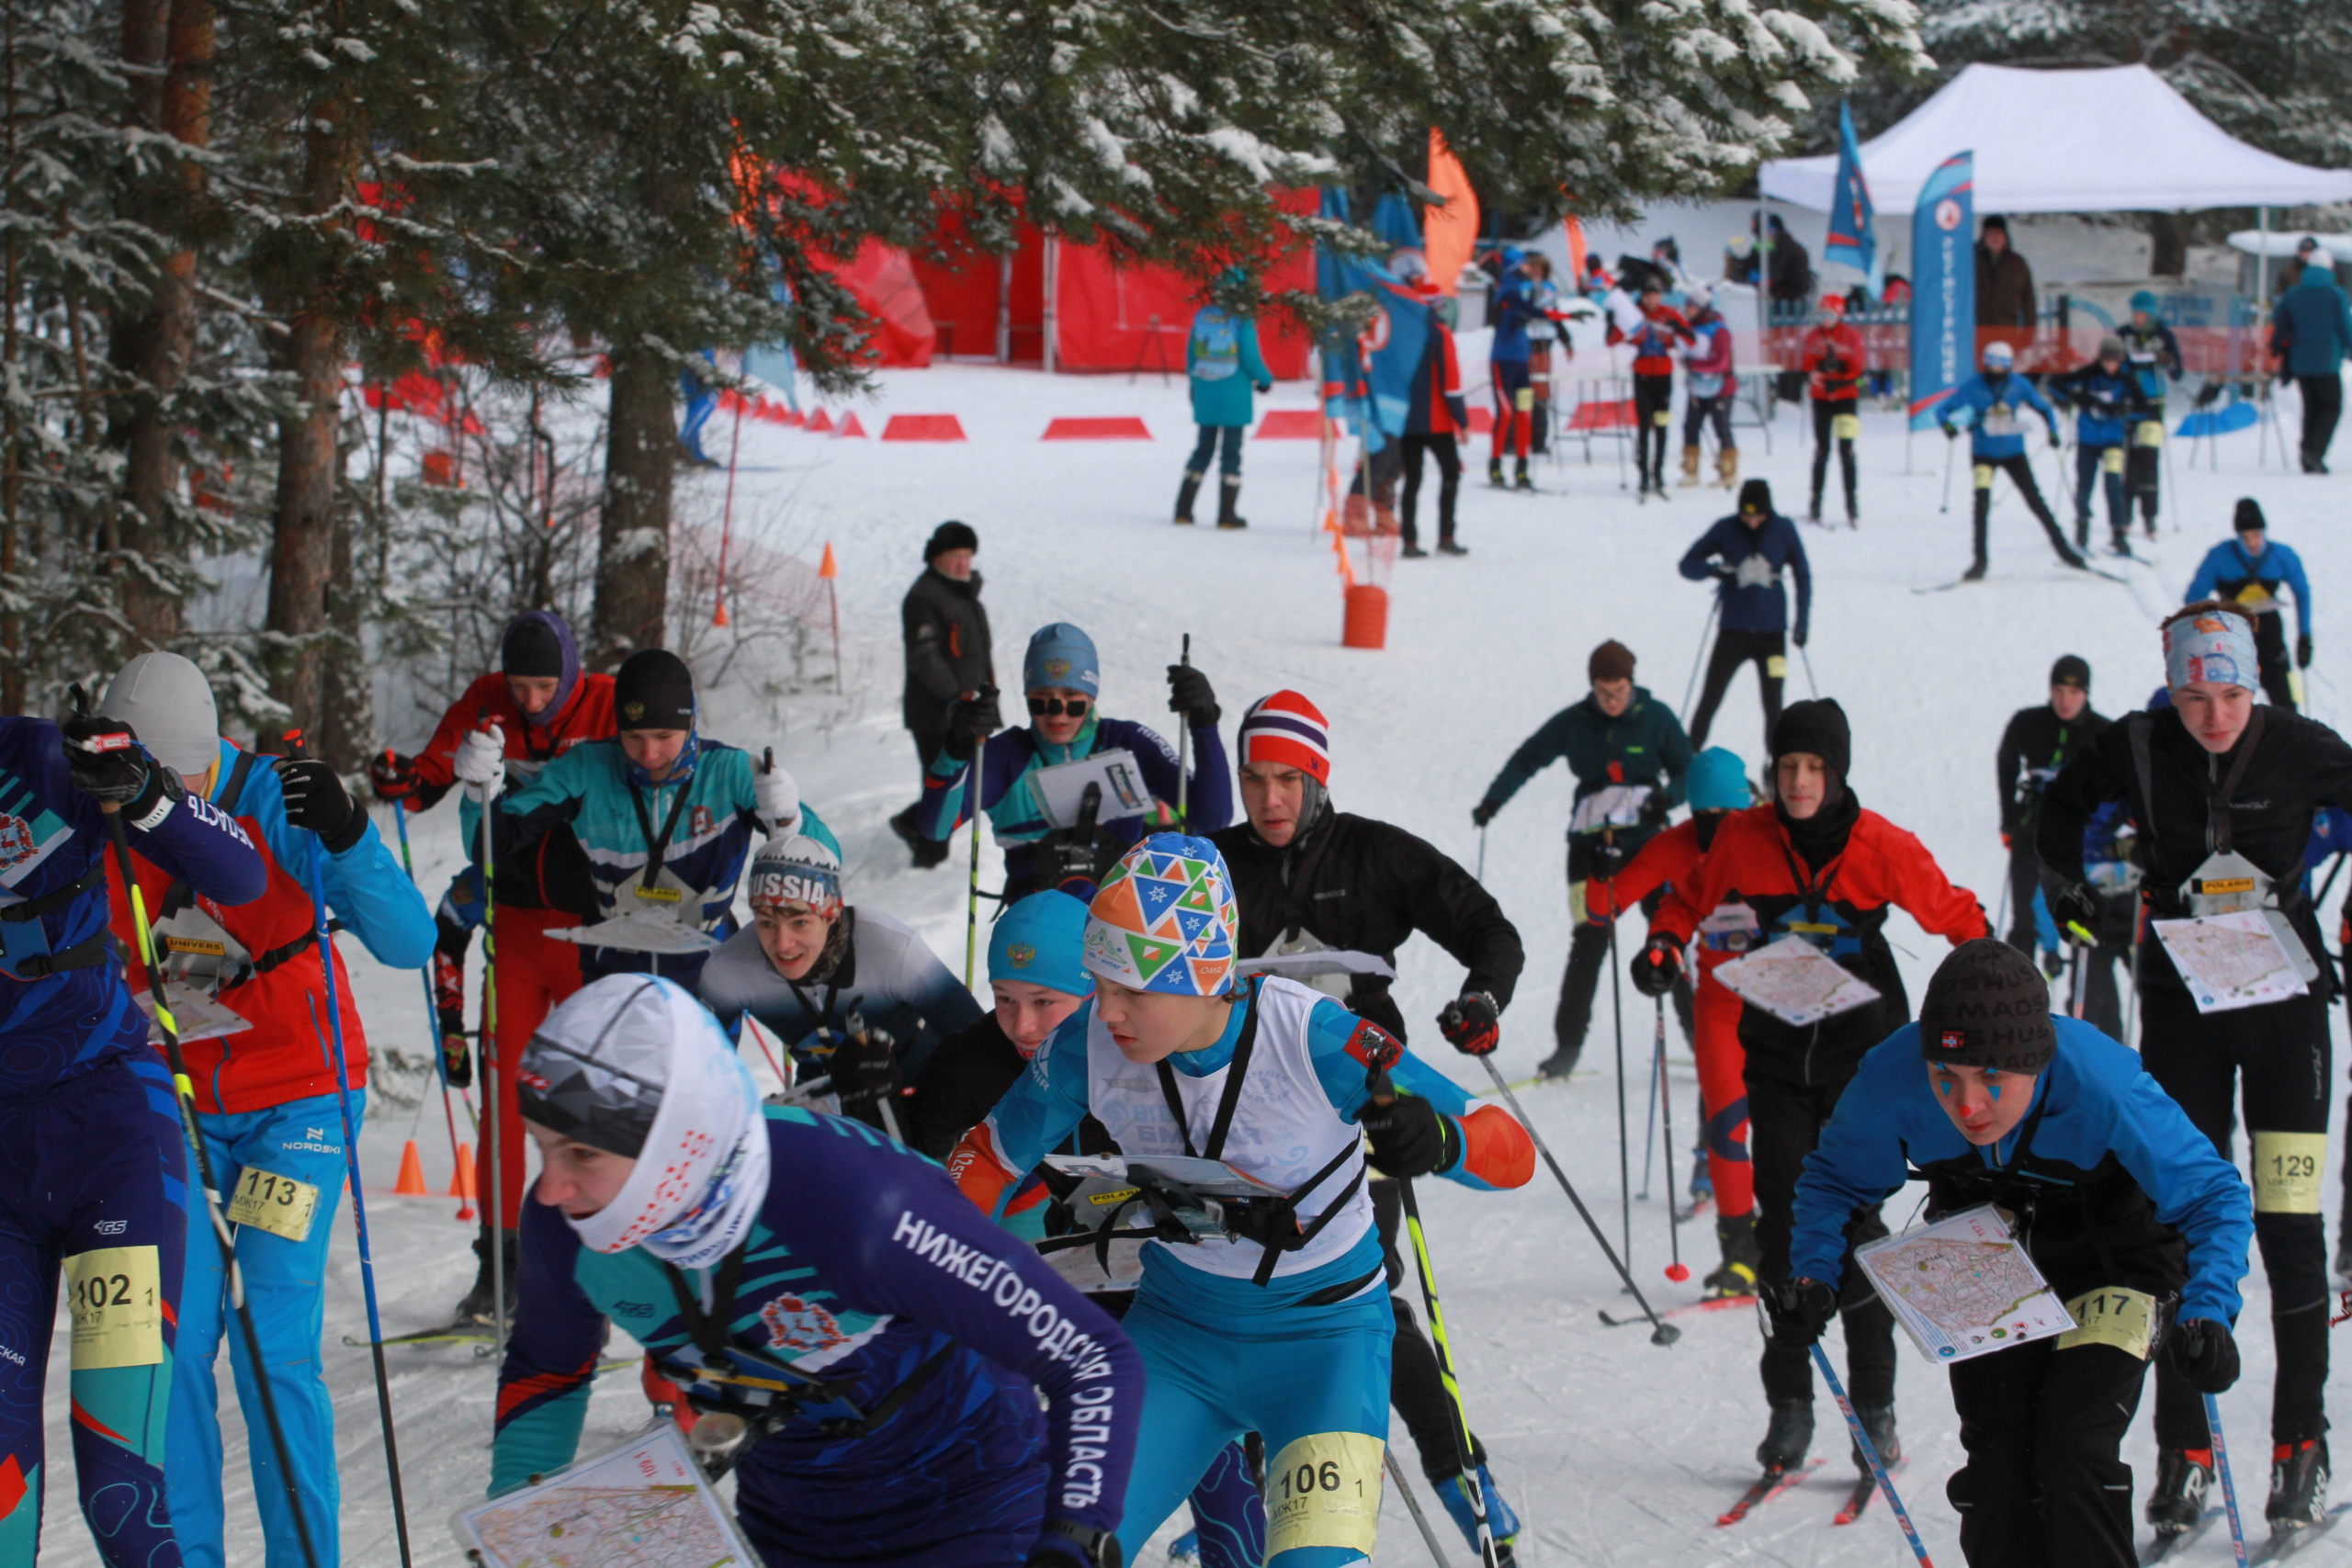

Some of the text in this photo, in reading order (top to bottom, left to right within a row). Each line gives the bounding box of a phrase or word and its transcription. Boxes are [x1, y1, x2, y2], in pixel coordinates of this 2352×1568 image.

[638, 887, 678, 897] POLARIS
[2205, 880, 2251, 890] POLARIS
[170, 940, 221, 951] UNIVERS
[1200, 966, 1223, 975] OMR
[282, 1142, 341, 1155] NORDSKI
[2272, 1155, 2315, 1177] 129
[248, 1171, 297, 1206] 113
[1093, 1190, 1140, 1201] POLARI
[232, 1195, 266, 1211] МЖ17
[78, 1273, 153, 1309] 102 1
[2075, 1293, 2130, 1320] 117
[1062, 1385, 1115, 1509] ОБЛАСТЬ
[1281, 1461, 1340, 1499] 106
[1355, 1478, 1363, 1498] 1
